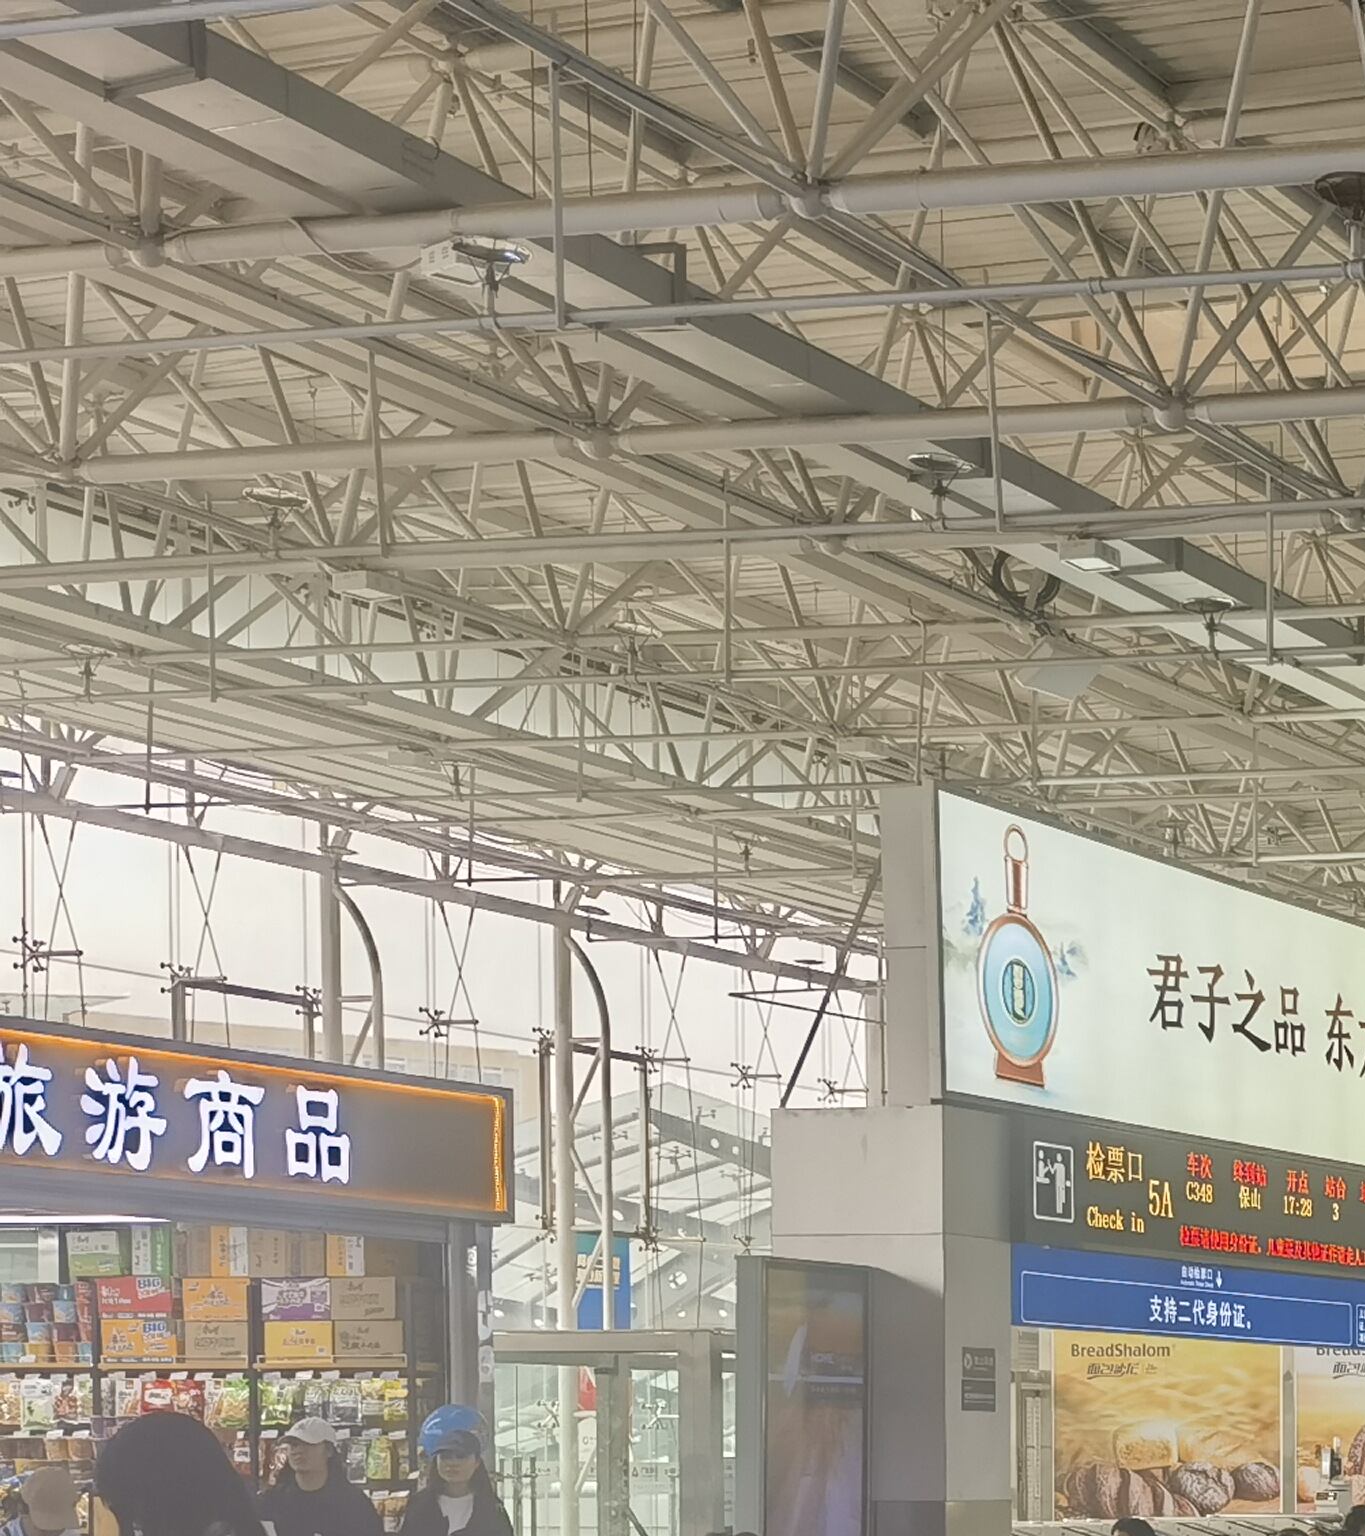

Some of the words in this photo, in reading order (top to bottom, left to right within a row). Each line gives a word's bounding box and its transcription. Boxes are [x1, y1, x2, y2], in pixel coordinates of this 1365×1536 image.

[1146, 954, 1307, 1057] 君子之品
[0, 1042, 351, 1184] 旅游商品
[1086, 1140, 1144, 1184] 检票口
[1186, 1151, 1213, 1180] 车次
[1233, 1159, 1268, 1187] 终到站
[1286, 1169, 1309, 1195] 开点
[1148, 1179, 1174, 1218] 5A
[1186, 1181, 1213, 1203] C348
[1239, 1186, 1261, 1210] 保山
[1283, 1195, 1312, 1217] 17:28
[1332, 1203, 1340, 1221] 3
[1087, 1206, 1124, 1231] Check
[1131, 1211, 1145, 1234] in
[1070, 1343, 1171, 1358] BreadShalom
